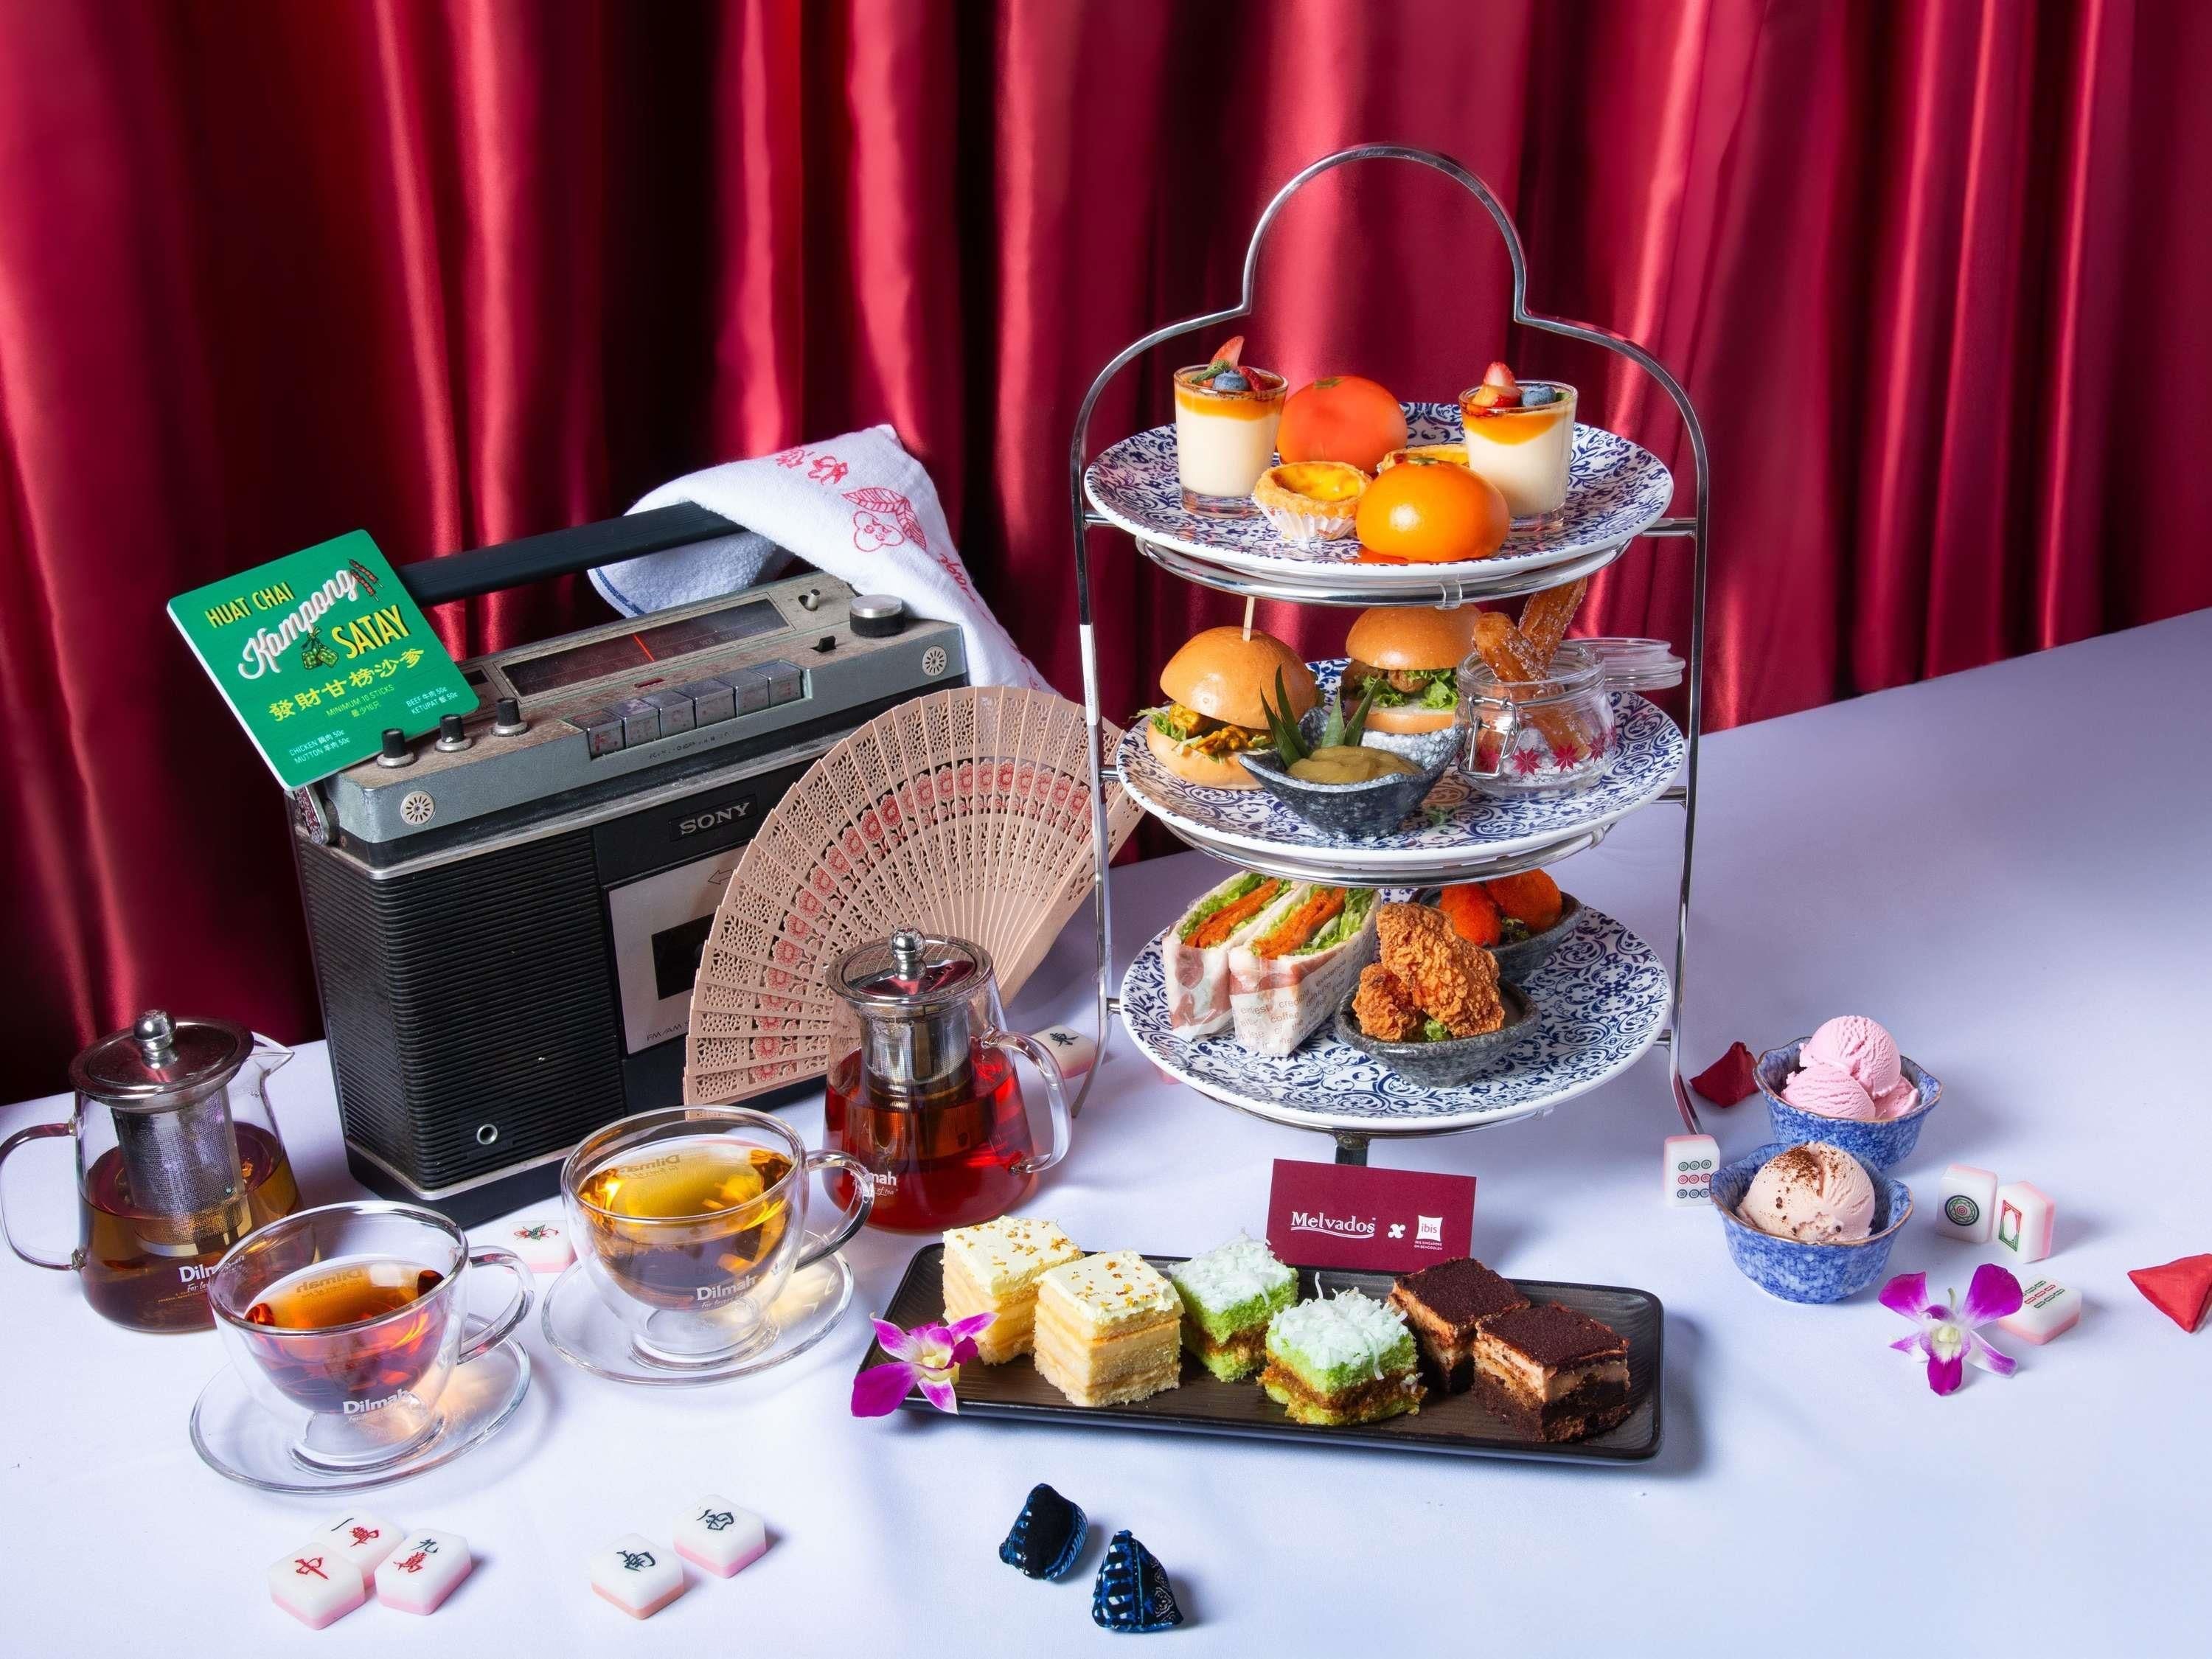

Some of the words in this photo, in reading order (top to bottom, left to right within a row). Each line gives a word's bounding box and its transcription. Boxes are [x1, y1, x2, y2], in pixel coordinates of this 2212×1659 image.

[204, 597, 251, 628] HUAT
[252, 582, 295, 611] CHAI
[237, 570, 359, 679] Kampong
[331, 605, 411, 659] SATAY
[326, 698, 361, 717] MINIMUM
[361, 694, 370, 703] 10
[370, 684, 394, 698] STICKS
[406, 696, 422, 707] BEEF
[411, 700, 439, 714] KETUPAT
[289, 740, 318, 756] CHICKEN
[293, 748, 324, 764] MUTTON
[679, 801, 751, 835] SONY
[1291, 1211, 1374, 1234] Melvados
[1421, 1223, 1438, 1234] ibis
[696, 1275, 757, 1301] Dilmah
[293, 1557, 330, 1582] 中
[616, 1549, 658, 1573] 南
